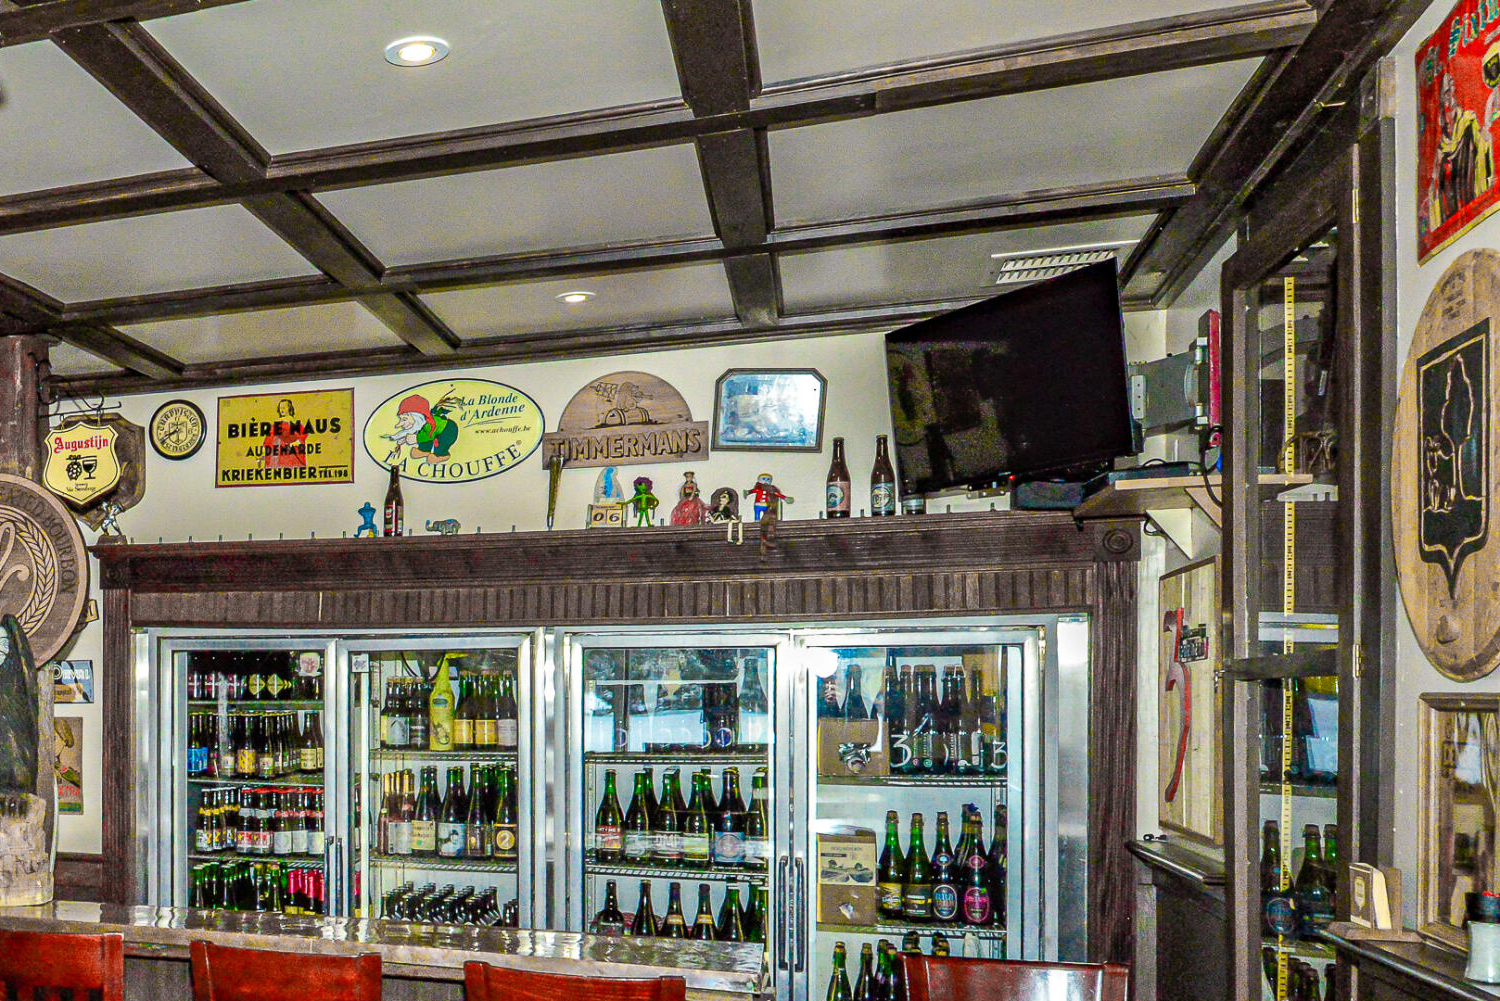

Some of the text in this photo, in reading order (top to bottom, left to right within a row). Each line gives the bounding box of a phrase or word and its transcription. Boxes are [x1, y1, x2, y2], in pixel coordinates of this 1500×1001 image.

[461, 392, 518, 406] La Blonde
[460, 402, 526, 422] d'Ardenne
[54, 435, 109, 454] Augustijn
[245, 443, 321, 457] AUDENARDE
[550, 428, 701, 460] TIMMERMANS
[418, 444, 521, 478] CHOUFFE
[222, 466, 317, 481] KRIEKENBIER
